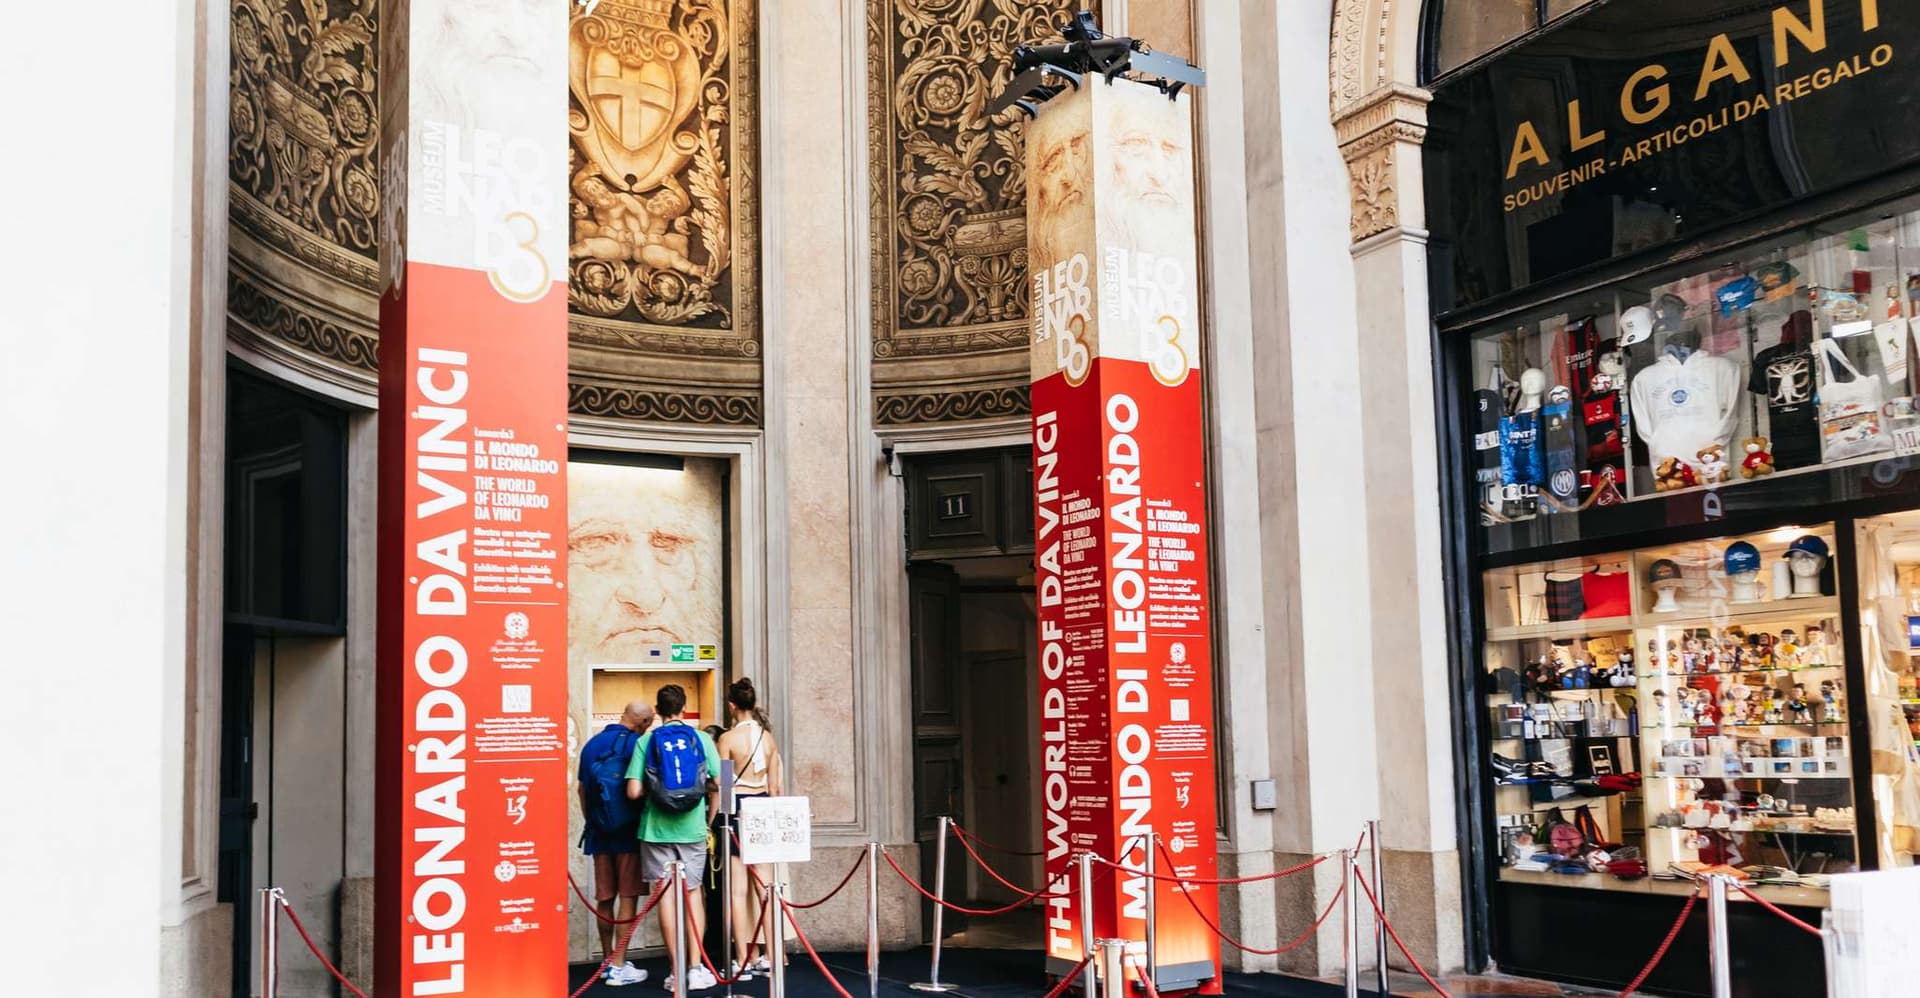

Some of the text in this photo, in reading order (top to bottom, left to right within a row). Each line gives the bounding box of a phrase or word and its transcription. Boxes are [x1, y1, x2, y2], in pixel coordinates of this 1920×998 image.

[1503, 157, 1606, 212] SOUVENIR
[1620, 106, 1729, 168] ARTICOLI
[1733, 92, 1770, 122] DA
[1775, 43, 1894, 105] REGALO
[1034, 272, 1045, 345] MUSEUM
[474, 454, 559, 475] DI LEONARDO
[488, 441, 539, 458] MONDO
[473, 475, 536, 493] THE WORLD
[474, 490, 549, 509] OF LEONARDO
[944, 496, 964, 516] 11
[474, 505, 521, 522] DA VINCI
[1106, 393, 1147, 653] LEONARDO
[412, 347, 469, 997] LEONARDO DA VINCI
[1036, 410, 1073, 955] THE WORLD OF DA VINCI
[1116, 669, 1149, 713] DI
[1117, 723, 1153, 920] MONDO
